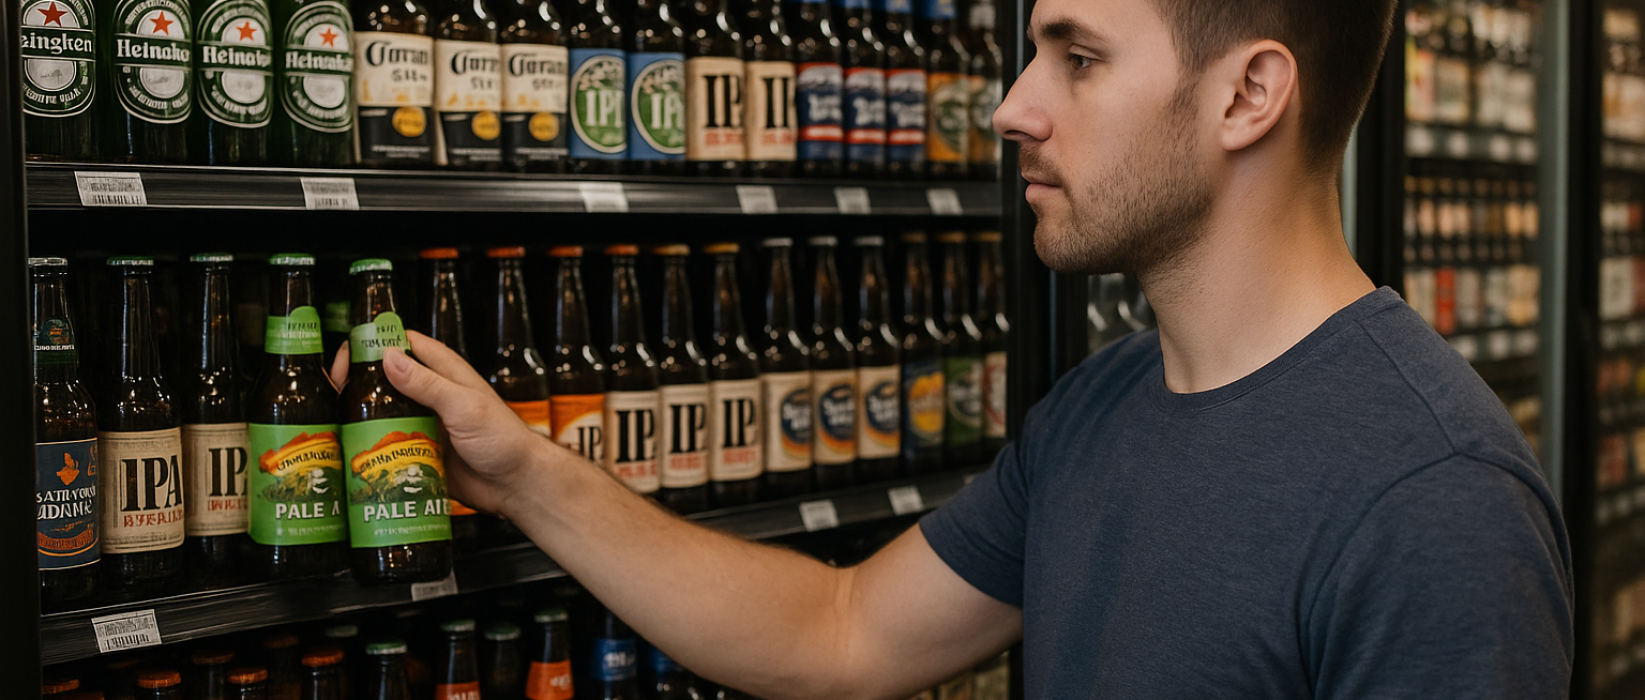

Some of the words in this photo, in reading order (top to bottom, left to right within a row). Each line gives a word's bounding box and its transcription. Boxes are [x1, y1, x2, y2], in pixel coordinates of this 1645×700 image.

[121, 455, 182, 511] IPA
[275, 502, 324, 519] PALE
[363, 501, 417, 522] PALE
